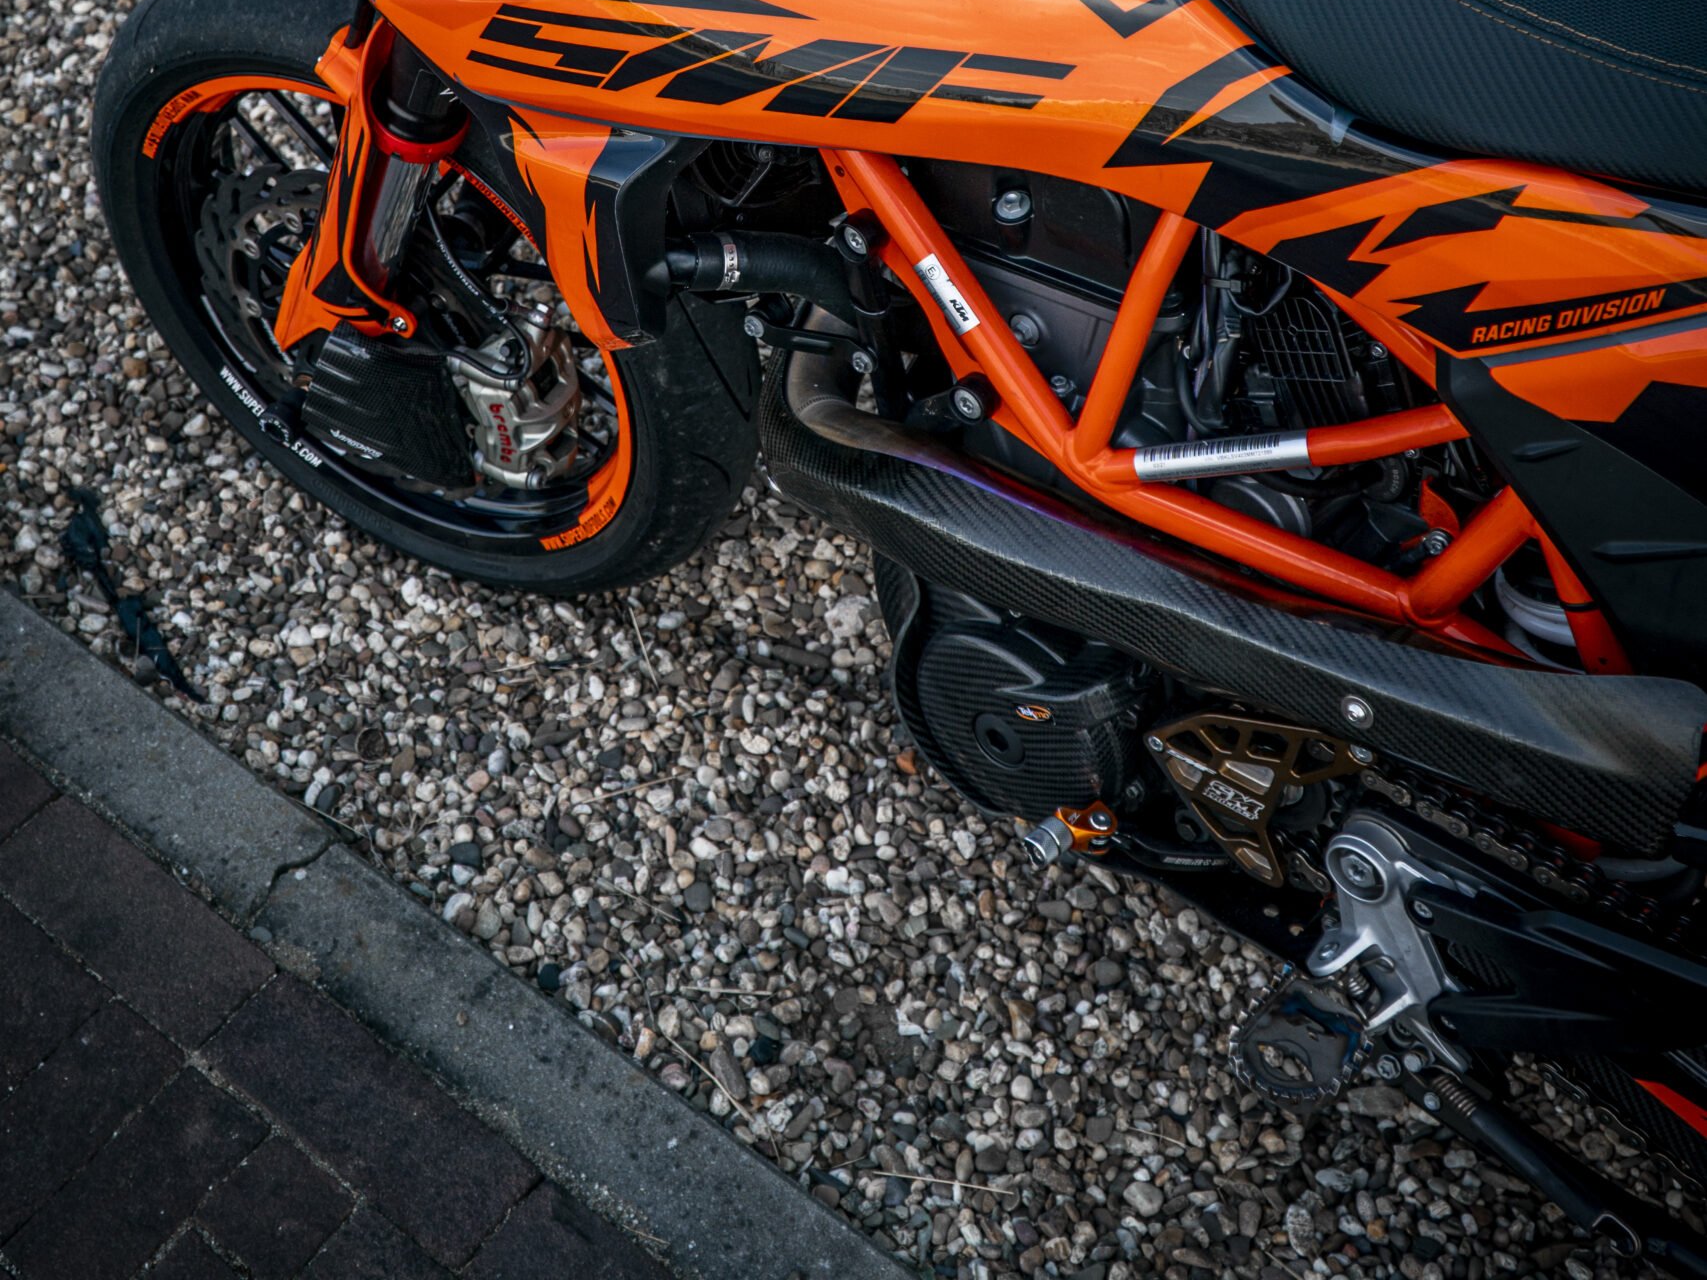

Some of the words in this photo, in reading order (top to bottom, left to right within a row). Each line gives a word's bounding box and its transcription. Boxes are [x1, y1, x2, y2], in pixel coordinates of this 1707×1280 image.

[949, 298, 970, 323] KTM
[1471, 314, 1553, 345] RACING
[1556, 287, 1668, 330] DIVISION
[488, 402, 519, 464] brembo
[1017, 705, 1051, 720] Tekmo
